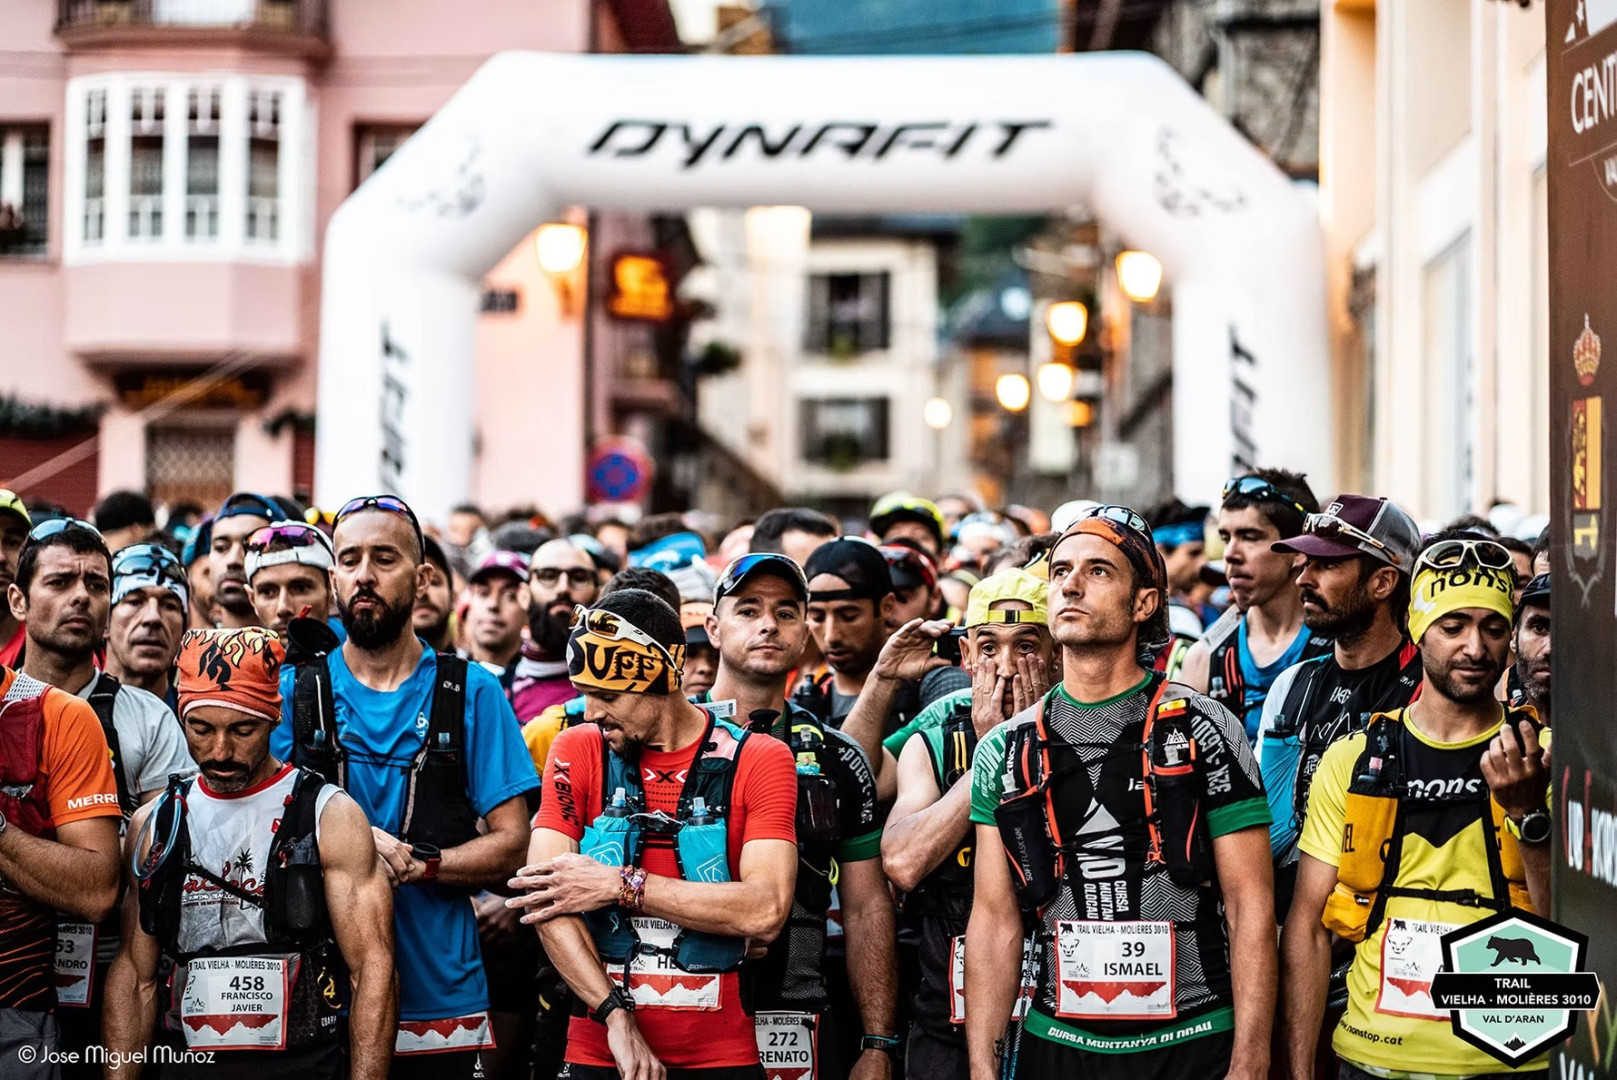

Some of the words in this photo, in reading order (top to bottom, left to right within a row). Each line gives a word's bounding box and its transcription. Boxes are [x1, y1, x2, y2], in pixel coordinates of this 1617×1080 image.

[587, 118, 1053, 170] DYNAFIT
[1114, 880, 1129, 912] CURSA
[1092, 925, 1115, 935] VIELHA
[1122, 941, 1145, 957] 39
[208, 960, 230, 970] VIELHA
[267, 961, 281, 971] 3010
[1104, 963, 1163, 976] ISMAEL
[229, 976, 265, 991] 458
[221, 992, 273, 1000] FRANCISCO
[231, 1004, 263, 1012] JAVIER
[768, 1031, 798, 1046] 272
[759, 1050, 809, 1063] RENATO
